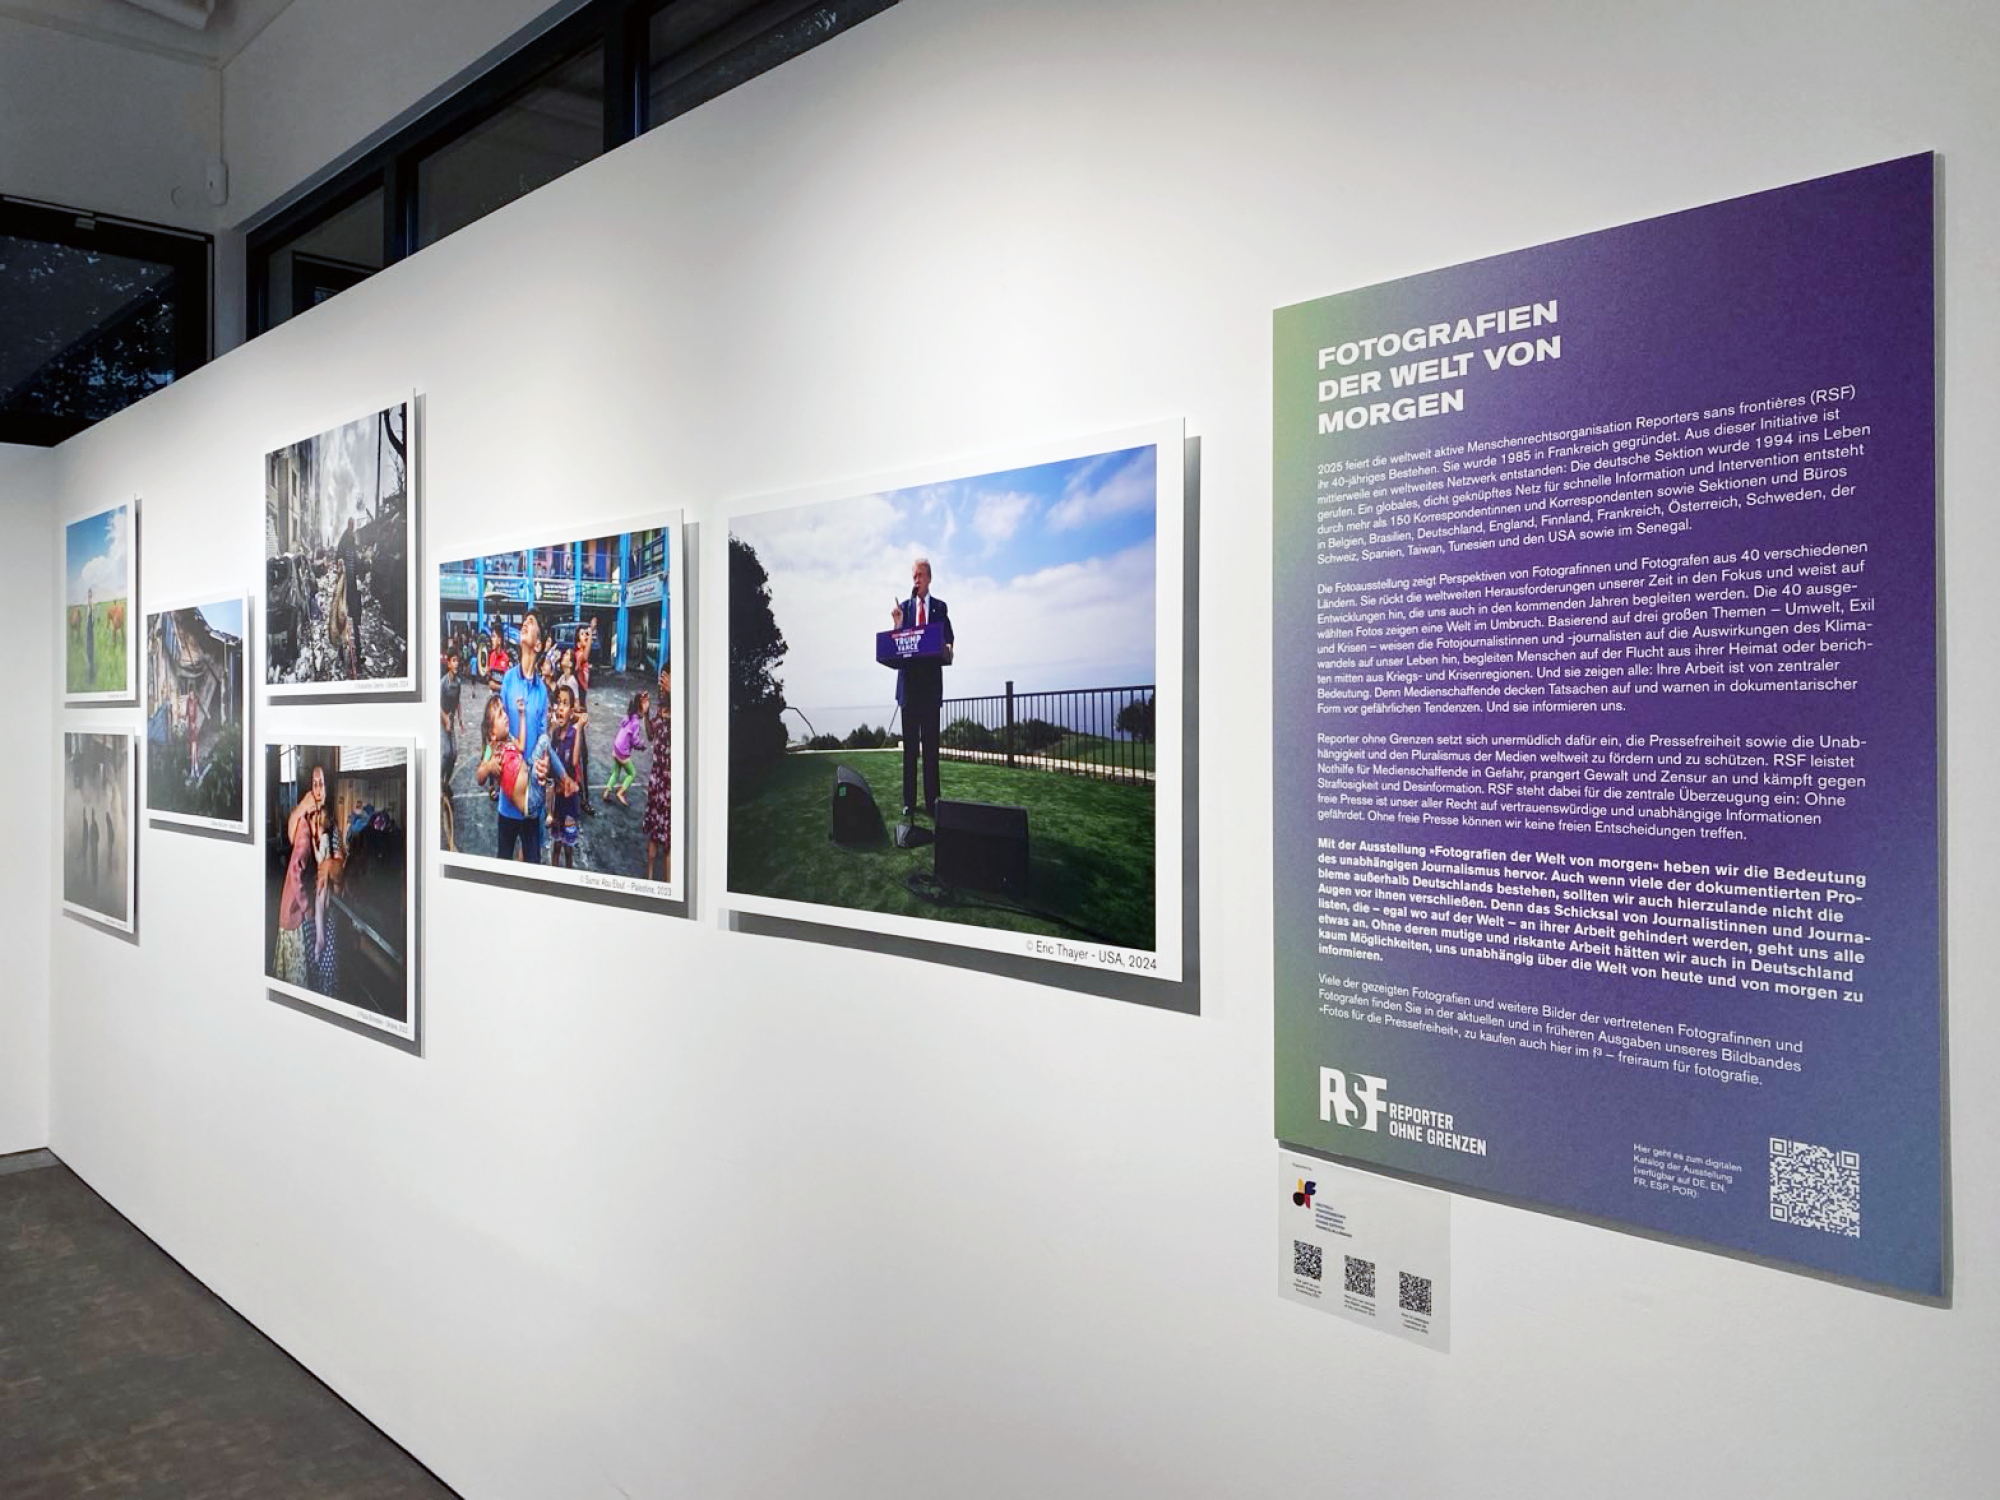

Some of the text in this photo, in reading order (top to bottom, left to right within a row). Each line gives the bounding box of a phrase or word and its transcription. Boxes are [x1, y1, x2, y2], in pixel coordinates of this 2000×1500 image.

[1318, 300, 1557, 369] FOTOGRAFIEN
[1318, 335, 1561, 402] DER WELT VON
[1317, 384, 1855, 474] 2025 feiert die weltweit aktive Menschenrechtsorganisation Reporters sans frontières (RSF)
[1318, 389, 1464, 434] MORGEN
[1317, 466, 1847, 534] durch mehr als 150 Korrespondentinnen und Korrespondenten sowie Sektionen und Büros
[1317, 517, 1692, 563] Schweiz, Spanien, Taiwan, Tunesien und den USA sowie im Senegal.
[1317, 542, 1867, 593] Die Fotoausstellung zeigt Perspektiven von Fotografinnen und Fotografen aus 40 verschiedenen
[1317, 676, 1857, 699] Bedeutung. Denn Medienschaffende decken Tatsachen auf und warnen in dokumentarischer
[1317, 792, 1821, 824] freie Presse ist unser aller Recht auf vertrauenswürdige und unabhängige Informationen
[1317, 808, 1746, 839] gefährdet. Ohne freie Presse können wir keine freien Entscheidungen treffen.
[1317, 837, 1866, 887] Mit der Ausstellung »Fotografien der Welt von morgen« heben wir die Bedeutung
[1317, 882, 1871, 943] Augen vor ihnen verschließen. Denn das Schicksal von Journalistinnen und Journa-
[1036, 940, 1054, 954] Eric
[1056, 944, 1088, 962] Thayer
[1098, 950, 1125, 966] USA,
[1128, 955, 1156, 970] 2024
[1318, 973, 1802, 1052] Viele der gezeigten Fotografien und weitere Bilder der vertretenen Fotografinnen und
[1319, 1066, 1387, 1132] RSF
[1389, 1102, 1453, 1131] REPORTER
[1389, 1119, 1486, 1156] OHNE GRENZEN
[1633, 1143, 1649, 1153] Hier
[1653, 1147, 1671, 1159] geht
[1686, 1155, 1703, 1164] zum
[1705, 1158, 1741, 1173] digitalen
[1633, 1154, 1732, 1183] Katalog der Ausstellung
[1677, 1175, 1690, 1185] auf
